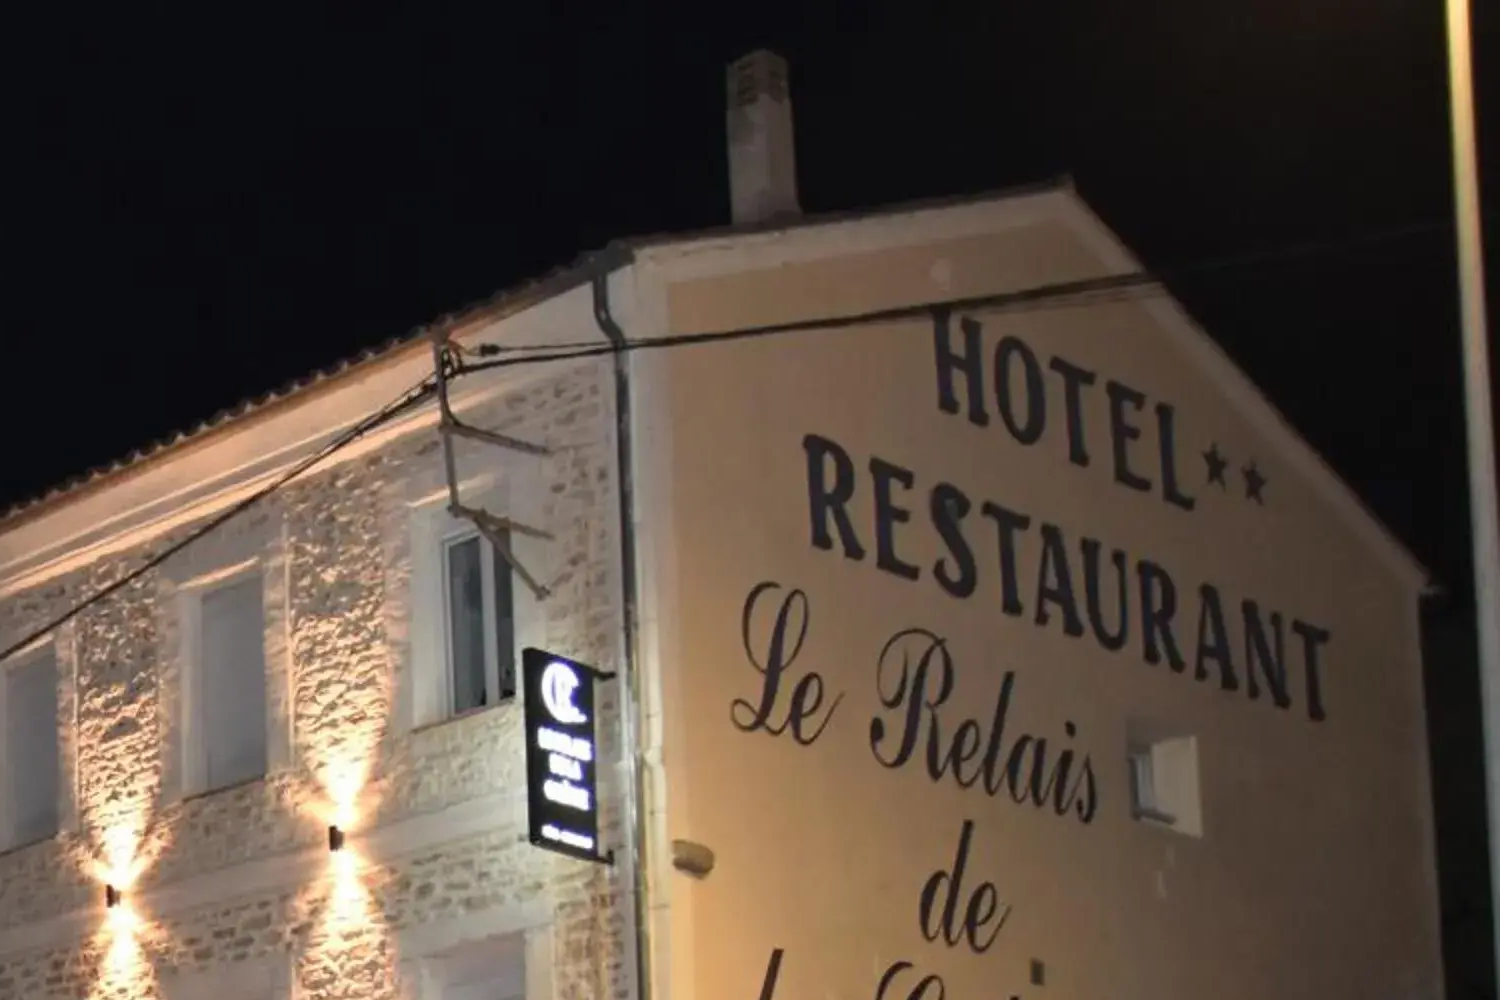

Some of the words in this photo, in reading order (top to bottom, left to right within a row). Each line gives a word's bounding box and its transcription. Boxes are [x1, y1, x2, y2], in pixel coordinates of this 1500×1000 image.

[930, 306, 1197, 512] HOTEL
[801, 433, 1331, 722] RESTAURANT
[729, 580, 846, 746] Le
[869, 627, 1098, 824] Relais
[918, 818, 1012, 954] de
